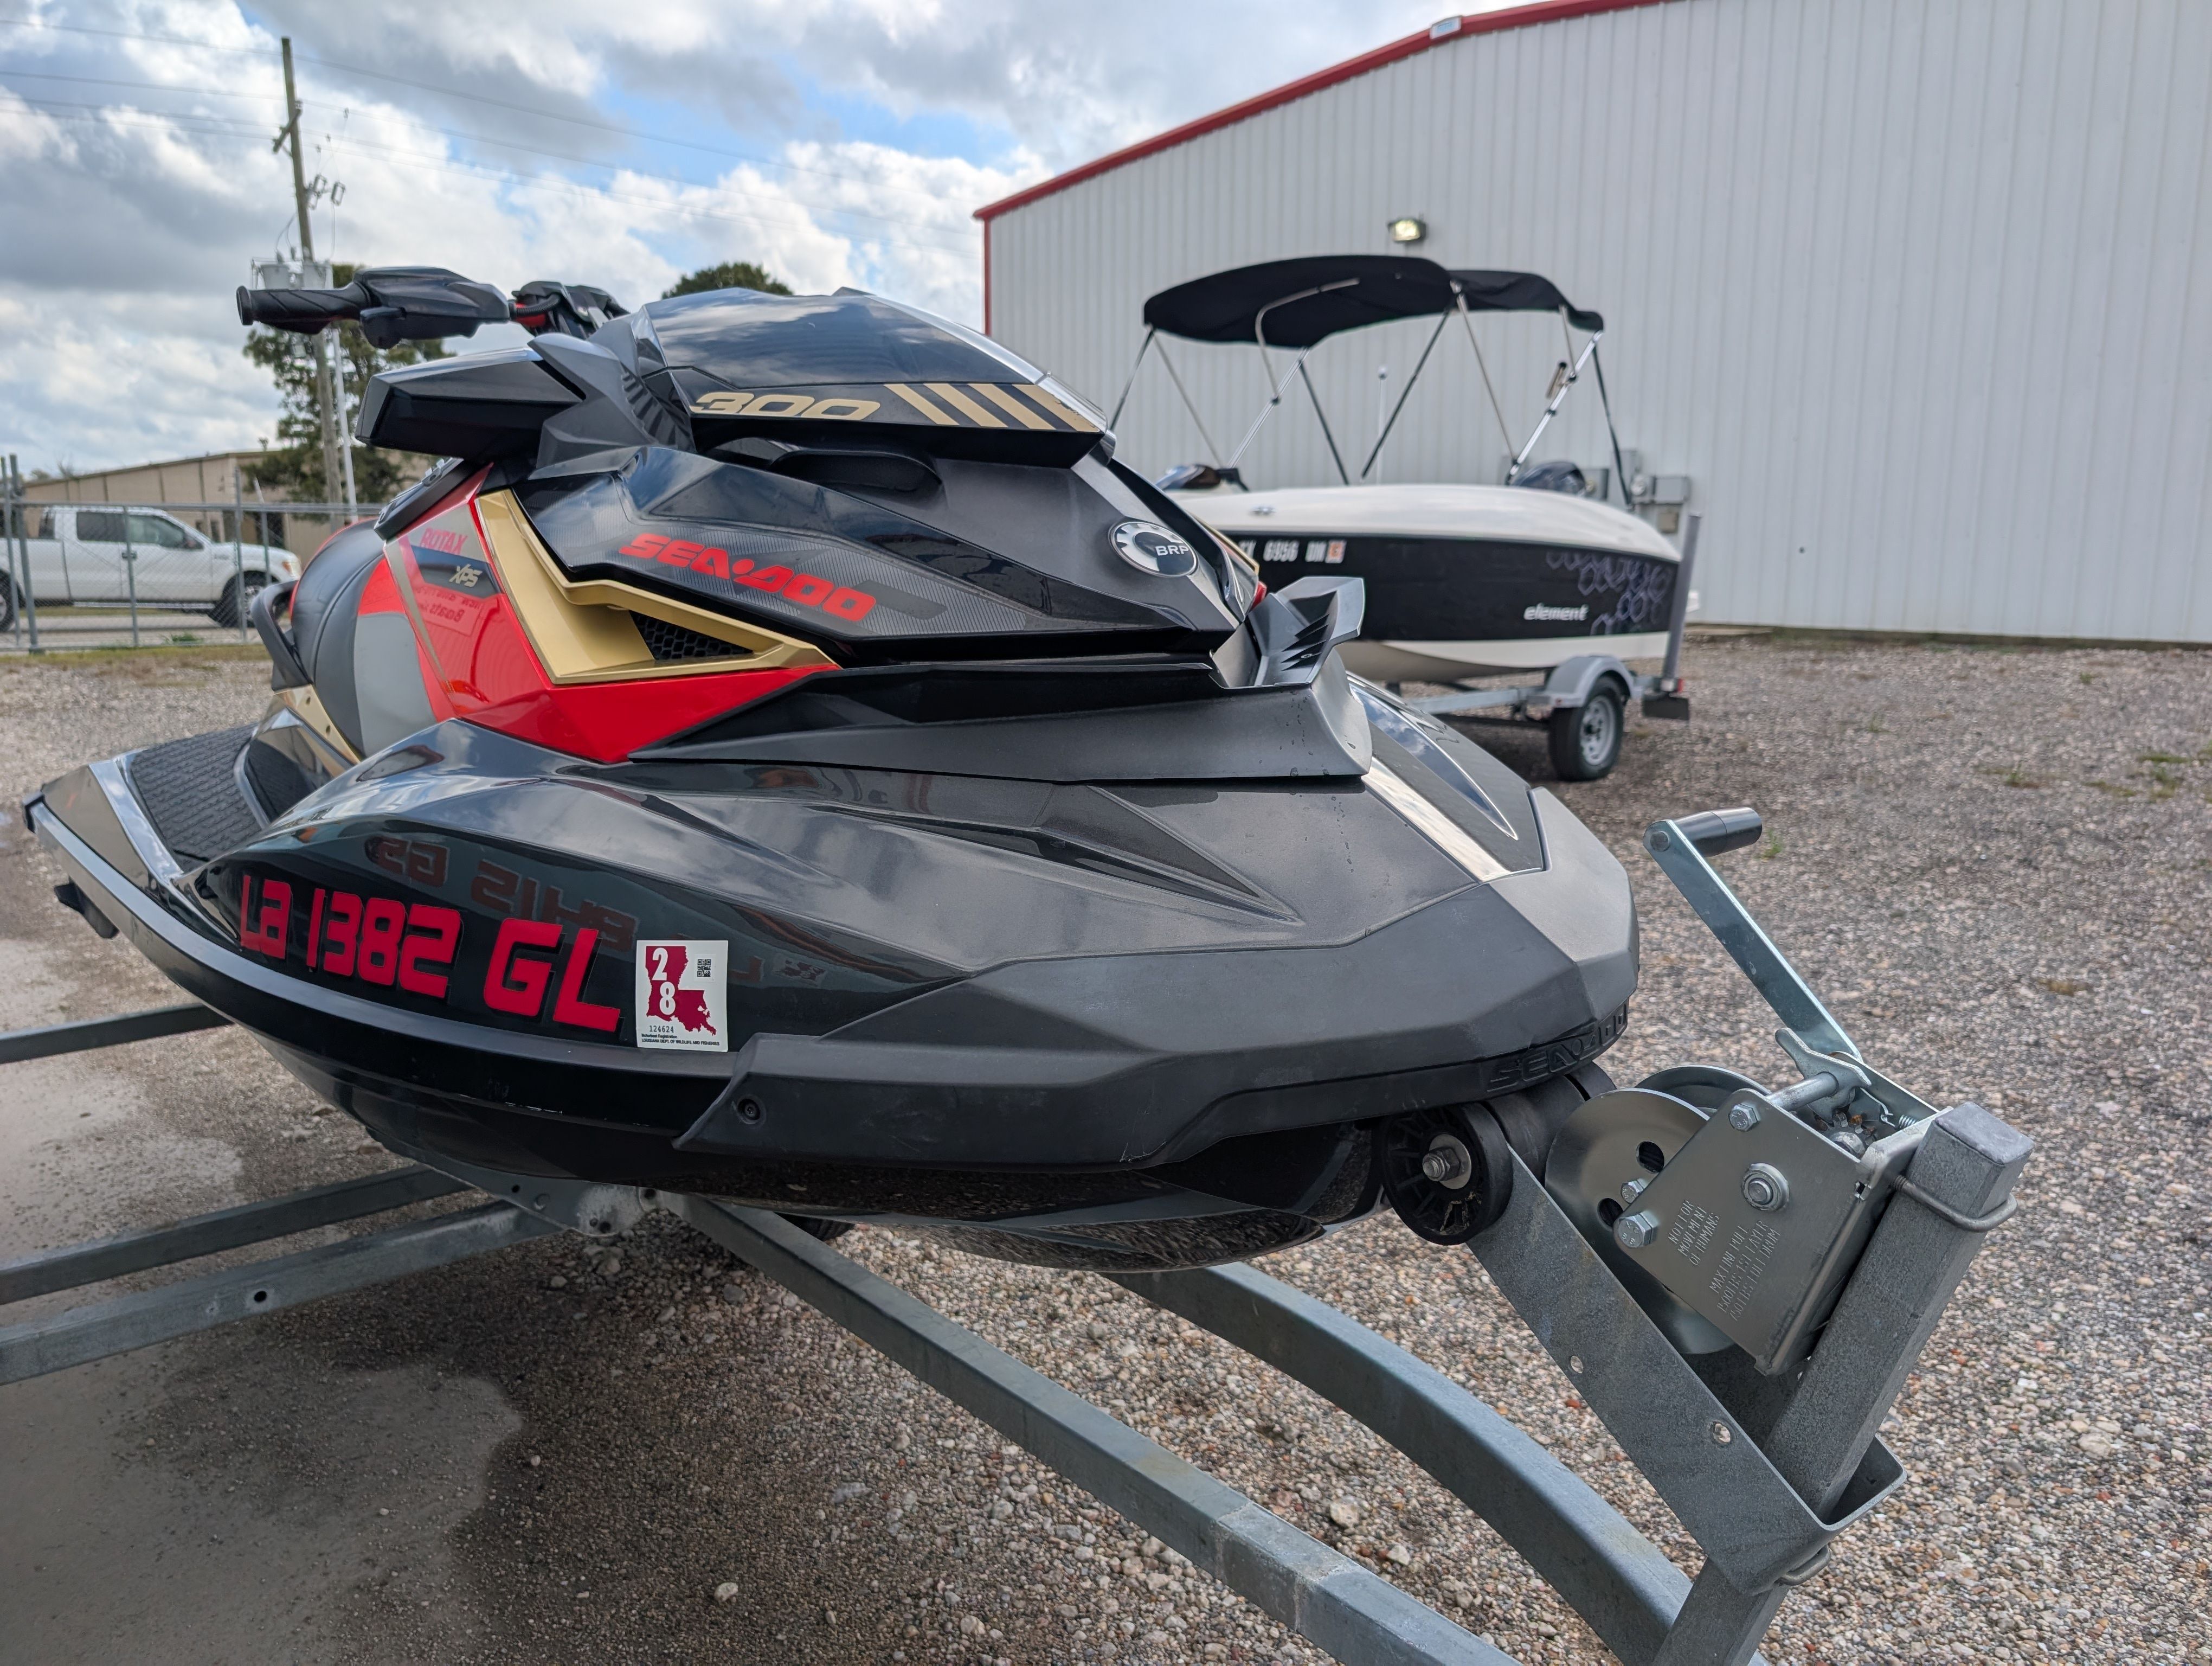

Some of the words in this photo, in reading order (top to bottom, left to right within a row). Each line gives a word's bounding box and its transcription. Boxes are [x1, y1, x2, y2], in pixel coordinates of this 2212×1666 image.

[689, 392, 881, 421] 300
[420, 527, 468, 555] ROTAX
[1155, 544, 1189, 556] BRP
[448, 563, 483, 587] XPS
[1523, 602, 1589, 621] element
[306, 888, 461, 999] 1382
[484, 917, 621, 1033] GL
[650, 1025, 674, 1033] 124624
[1668, 1221, 1684, 1245] NOT
[1677, 1200, 1694, 1223] FOR
[1694, 1213, 1719, 1253] HUMANS
[1759, 1227, 1781, 1259] DRUM
[1709, 1269, 1727, 1295] MAX
